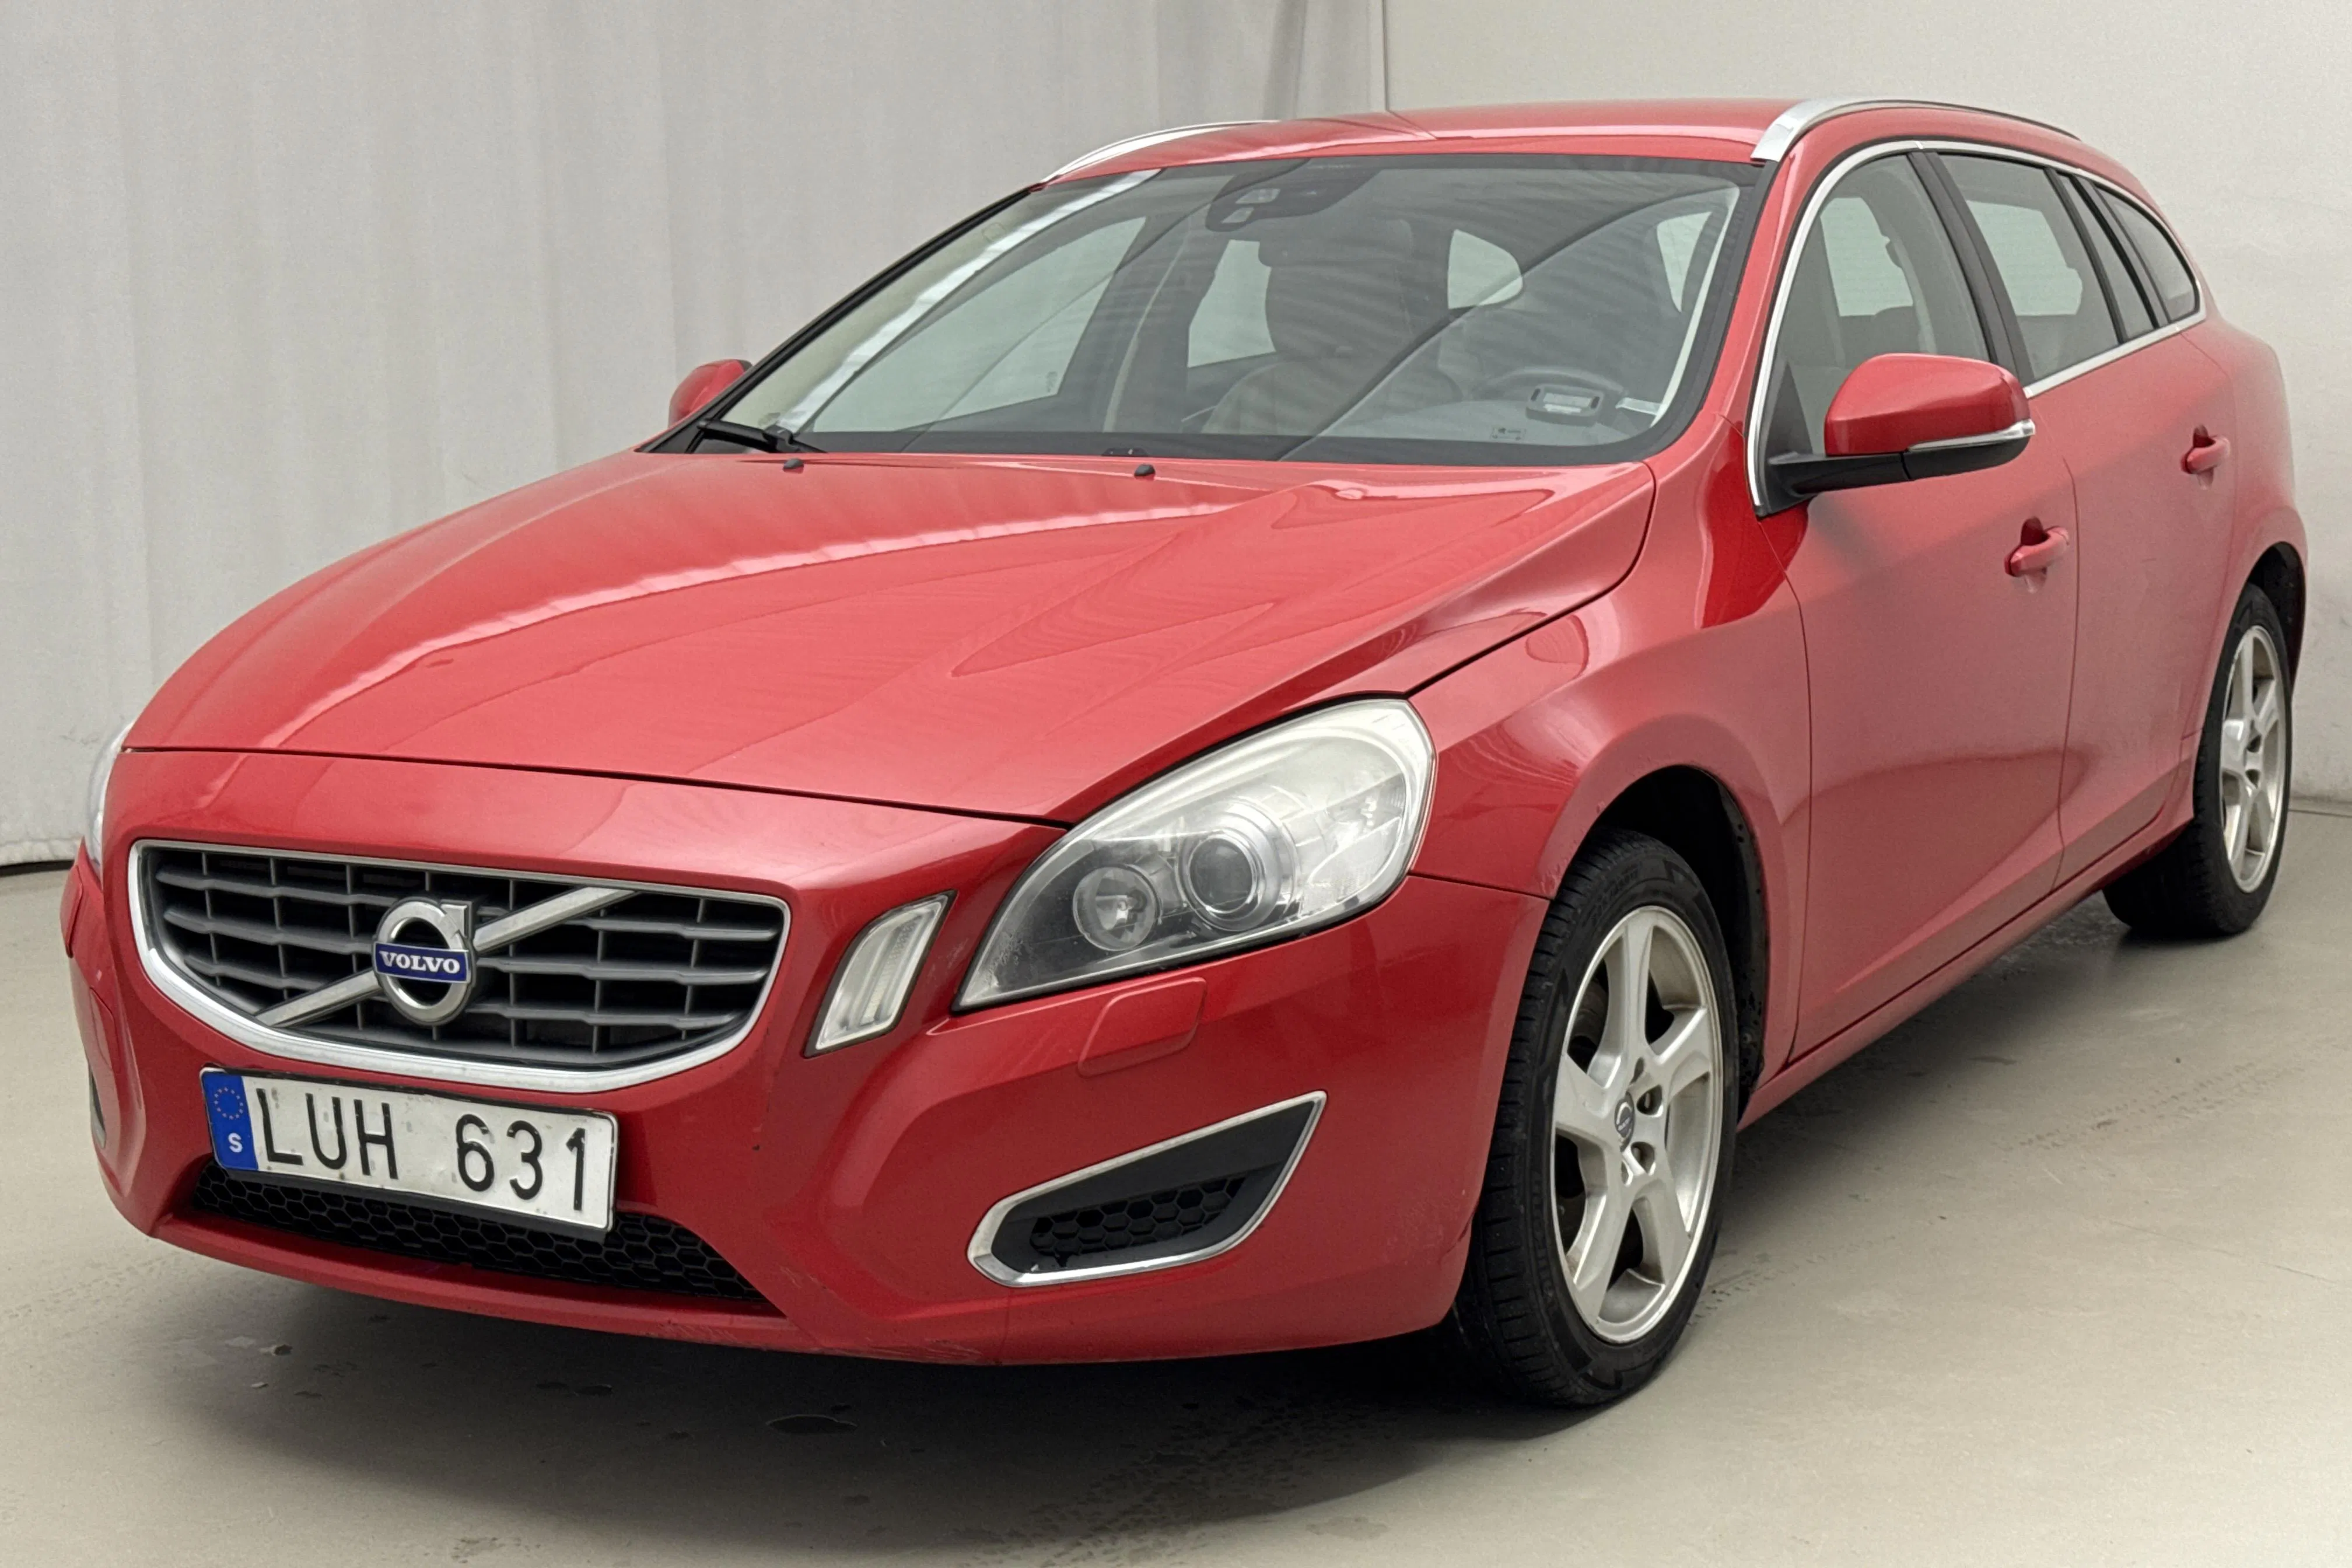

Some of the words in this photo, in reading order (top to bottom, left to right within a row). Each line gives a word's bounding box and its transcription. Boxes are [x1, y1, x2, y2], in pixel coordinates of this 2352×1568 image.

[379, 950, 460, 974] VOLVO
[228, 1132, 243, 1153] S
[256, 1088, 398, 1180] LUH
[456, 1114, 586, 1211] 631
